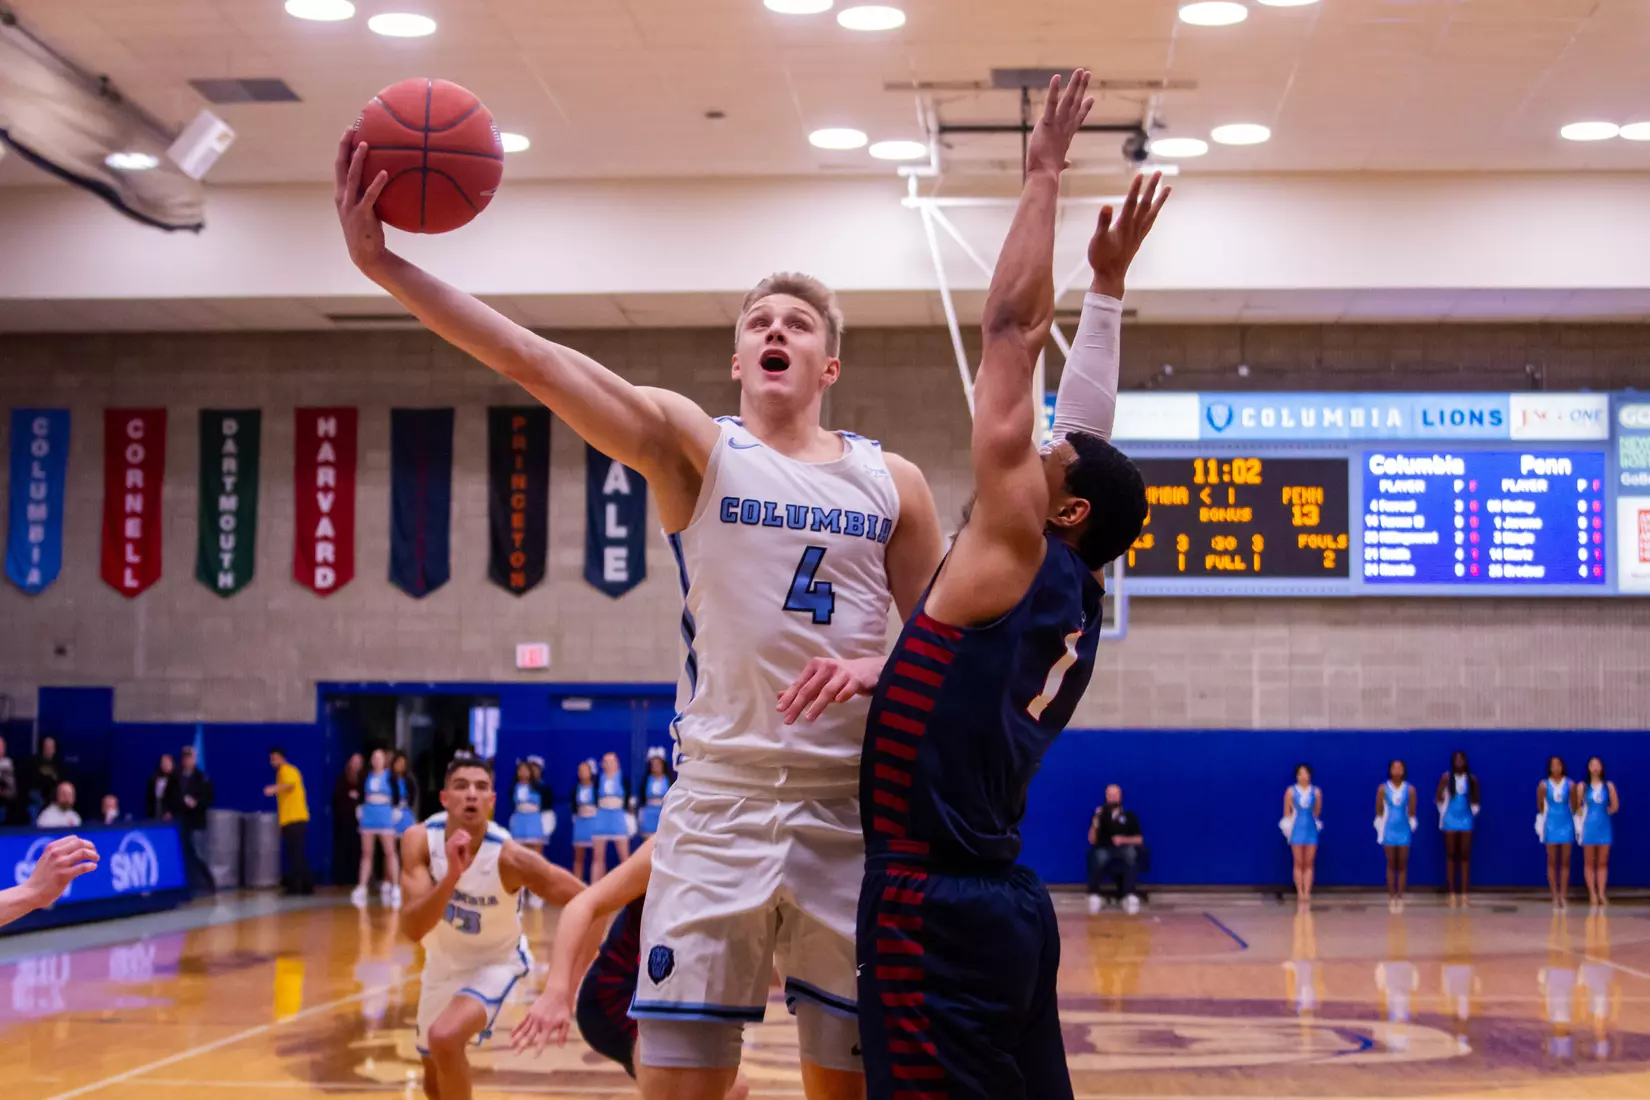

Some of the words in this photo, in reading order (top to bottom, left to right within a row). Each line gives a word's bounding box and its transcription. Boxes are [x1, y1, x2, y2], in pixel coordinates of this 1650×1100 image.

[1241, 407, 1403, 428] COLUMBIA
[1421, 408, 1504, 427] LIONS
[1193, 457, 1262, 484] 11:02
[1368, 453, 1465, 476] Columbia
[1520, 454, 1572, 476] Penn
[26, 416, 49, 586] COLUMBIA
[123, 418, 145, 588] CORNELL
[218, 418, 239, 589] DARTMOUTH
[314, 416, 337, 589] HARVARD
[510, 415, 527, 588] PRINCETON
[1199, 507, 1253, 522] BONUS
[1282, 486, 1324, 505] PENN
[602, 459, 631, 583] ALE
[720, 495, 892, 544] COLUMBIA
[1291, 504, 1320, 527] 13
[1297, 533, 1349, 549] FOULS
[1205, 554, 1247, 571] FULL
[782, 546, 835, 625] 4
[1026, 628, 1084, 723] 1
